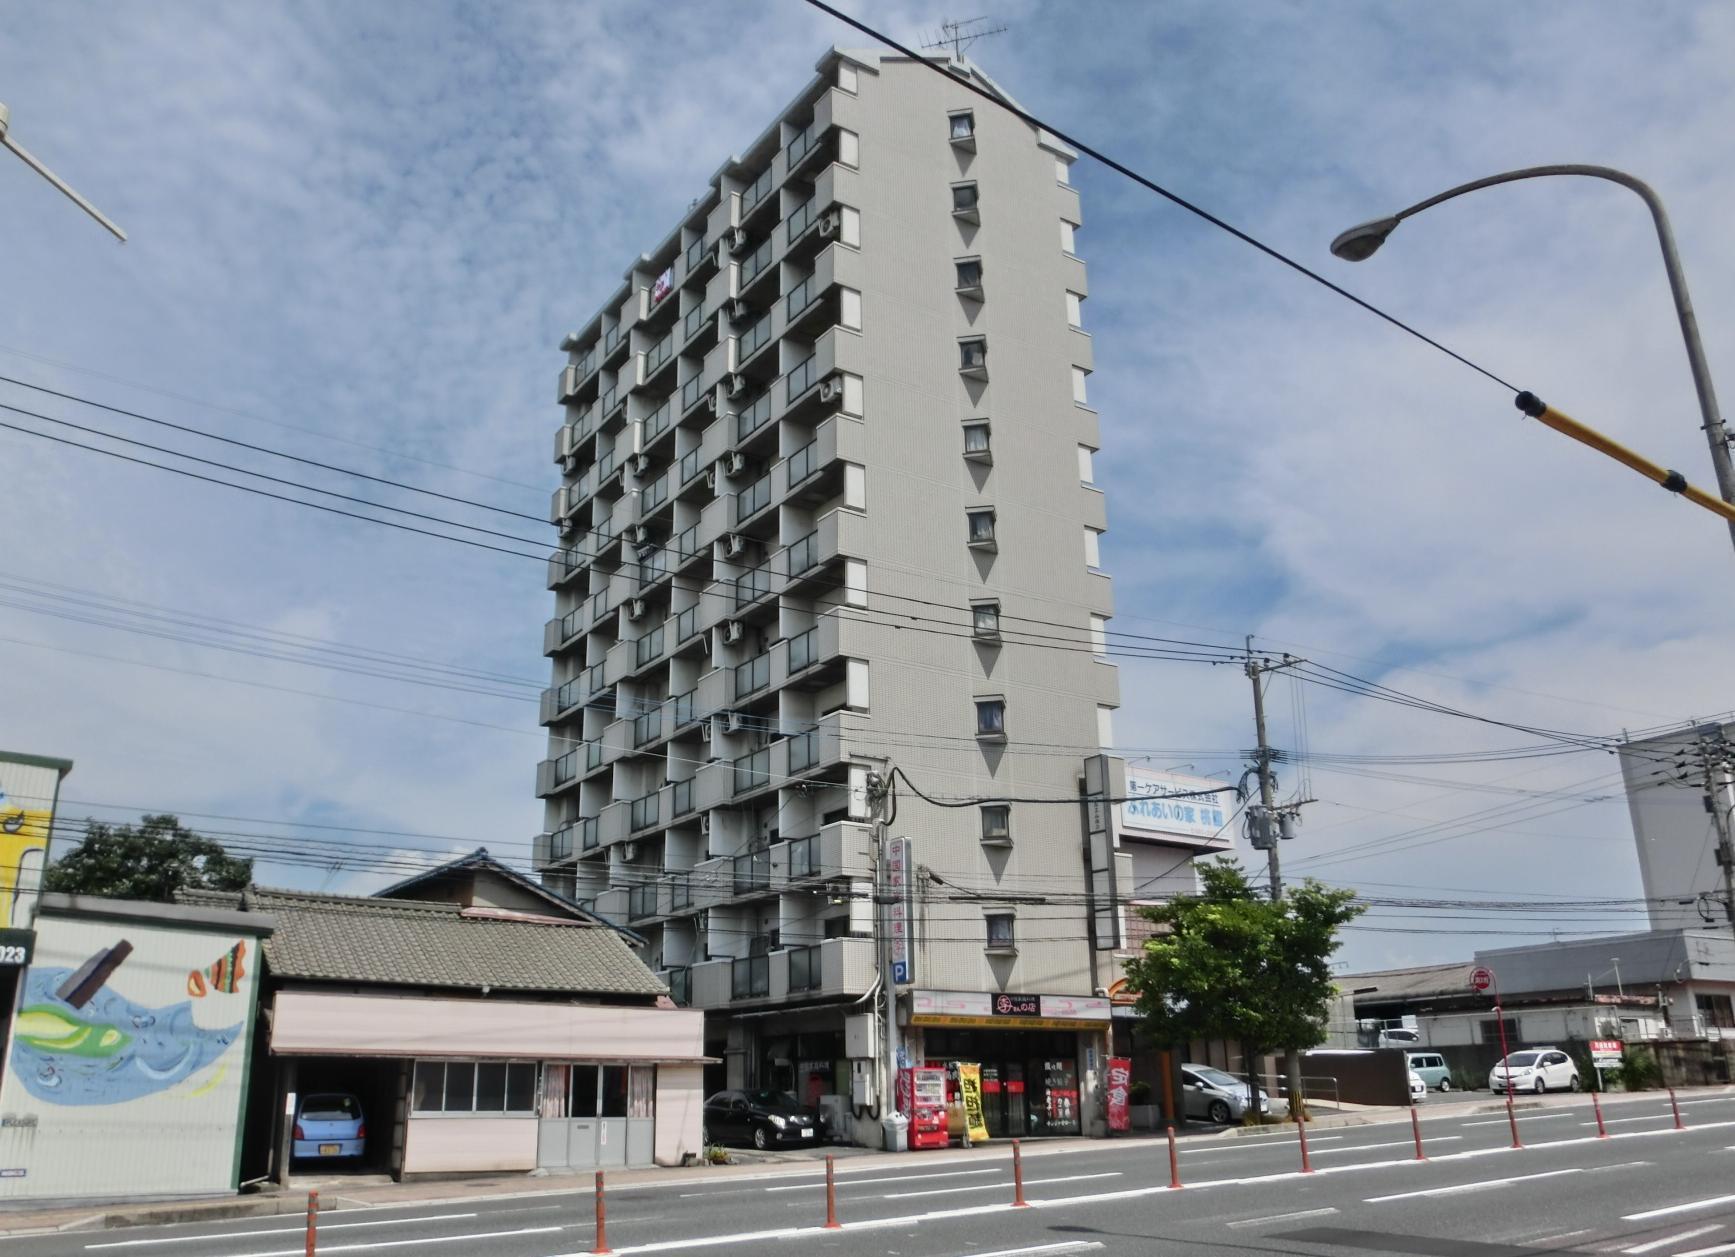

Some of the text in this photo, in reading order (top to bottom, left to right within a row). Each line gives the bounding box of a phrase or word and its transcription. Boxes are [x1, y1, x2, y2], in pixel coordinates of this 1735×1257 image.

[891, 845, 904, 934] 中国家料理
[895, 966, 904, 981] P
